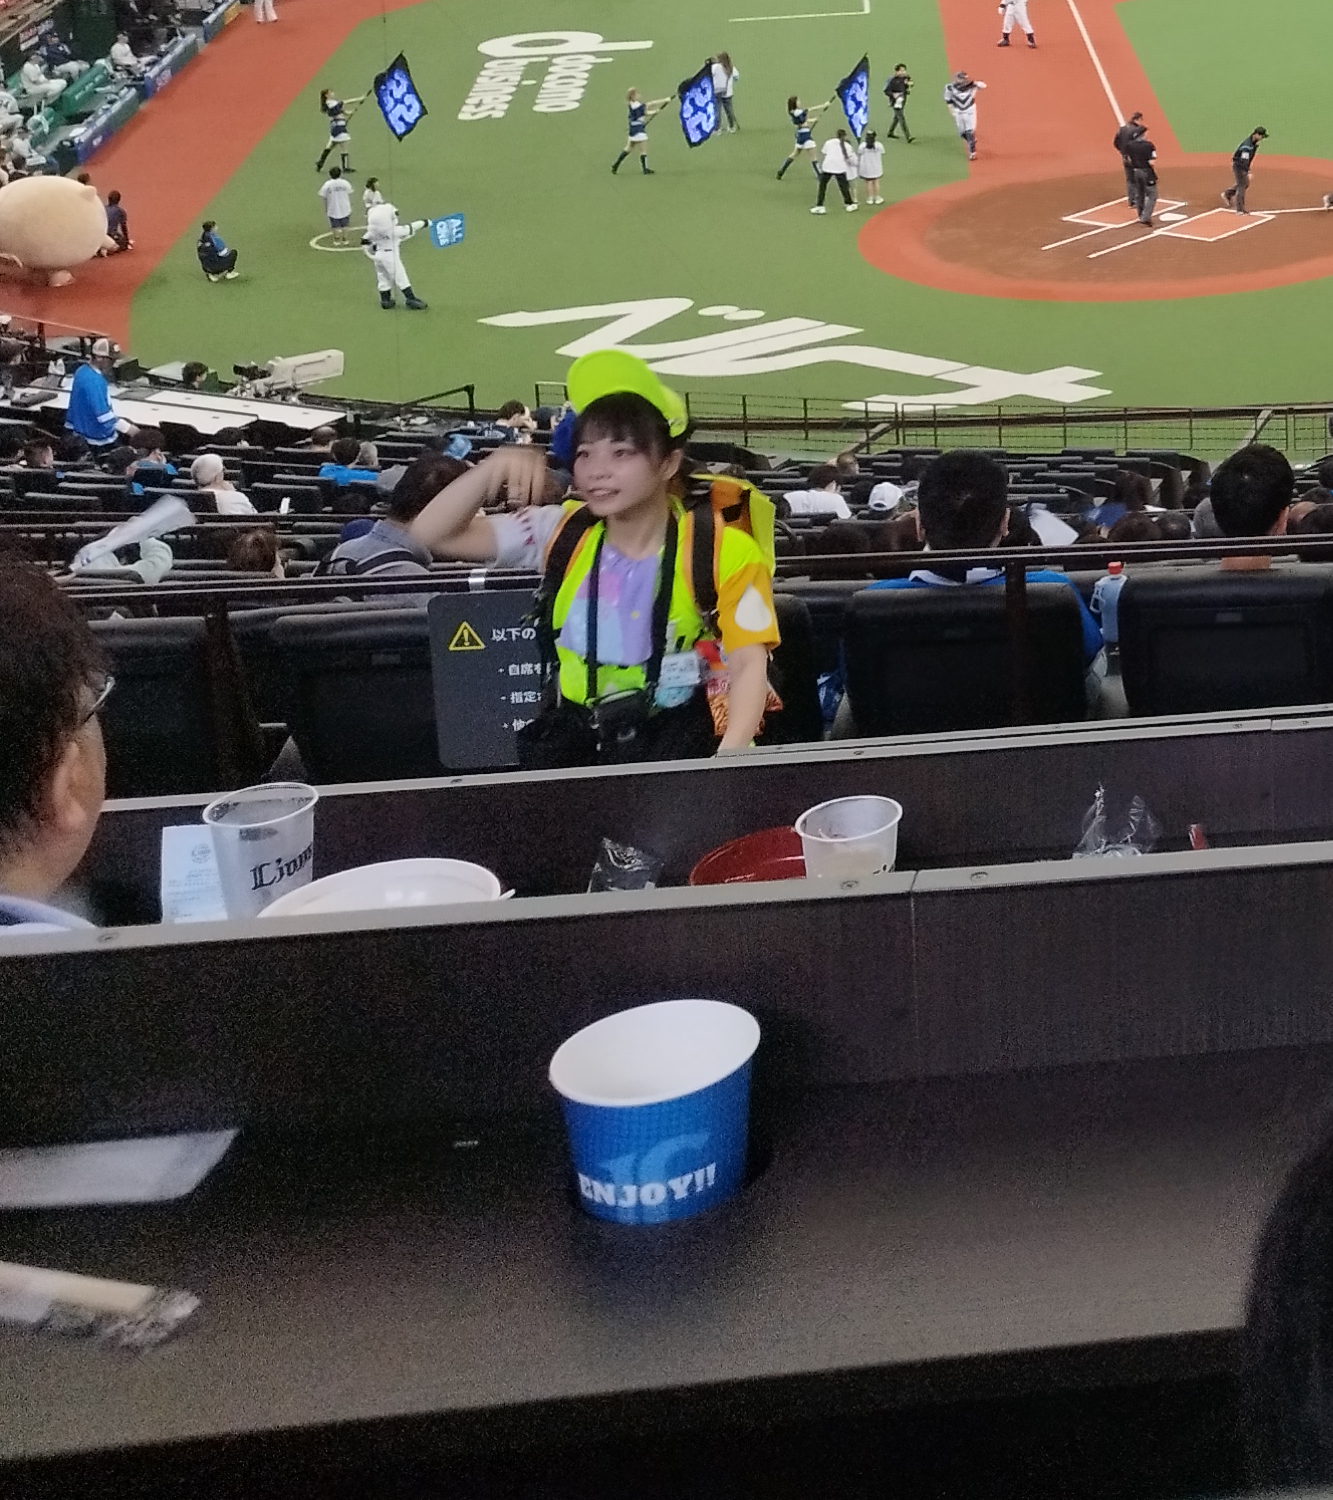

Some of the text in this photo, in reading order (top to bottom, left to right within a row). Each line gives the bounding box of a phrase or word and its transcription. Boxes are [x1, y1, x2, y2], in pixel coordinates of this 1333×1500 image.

[491, 627, 536, 642] 以下の
[510, 690, 542, 704] 指定
[577, 1161, 717, 1209] ENJOY!!
